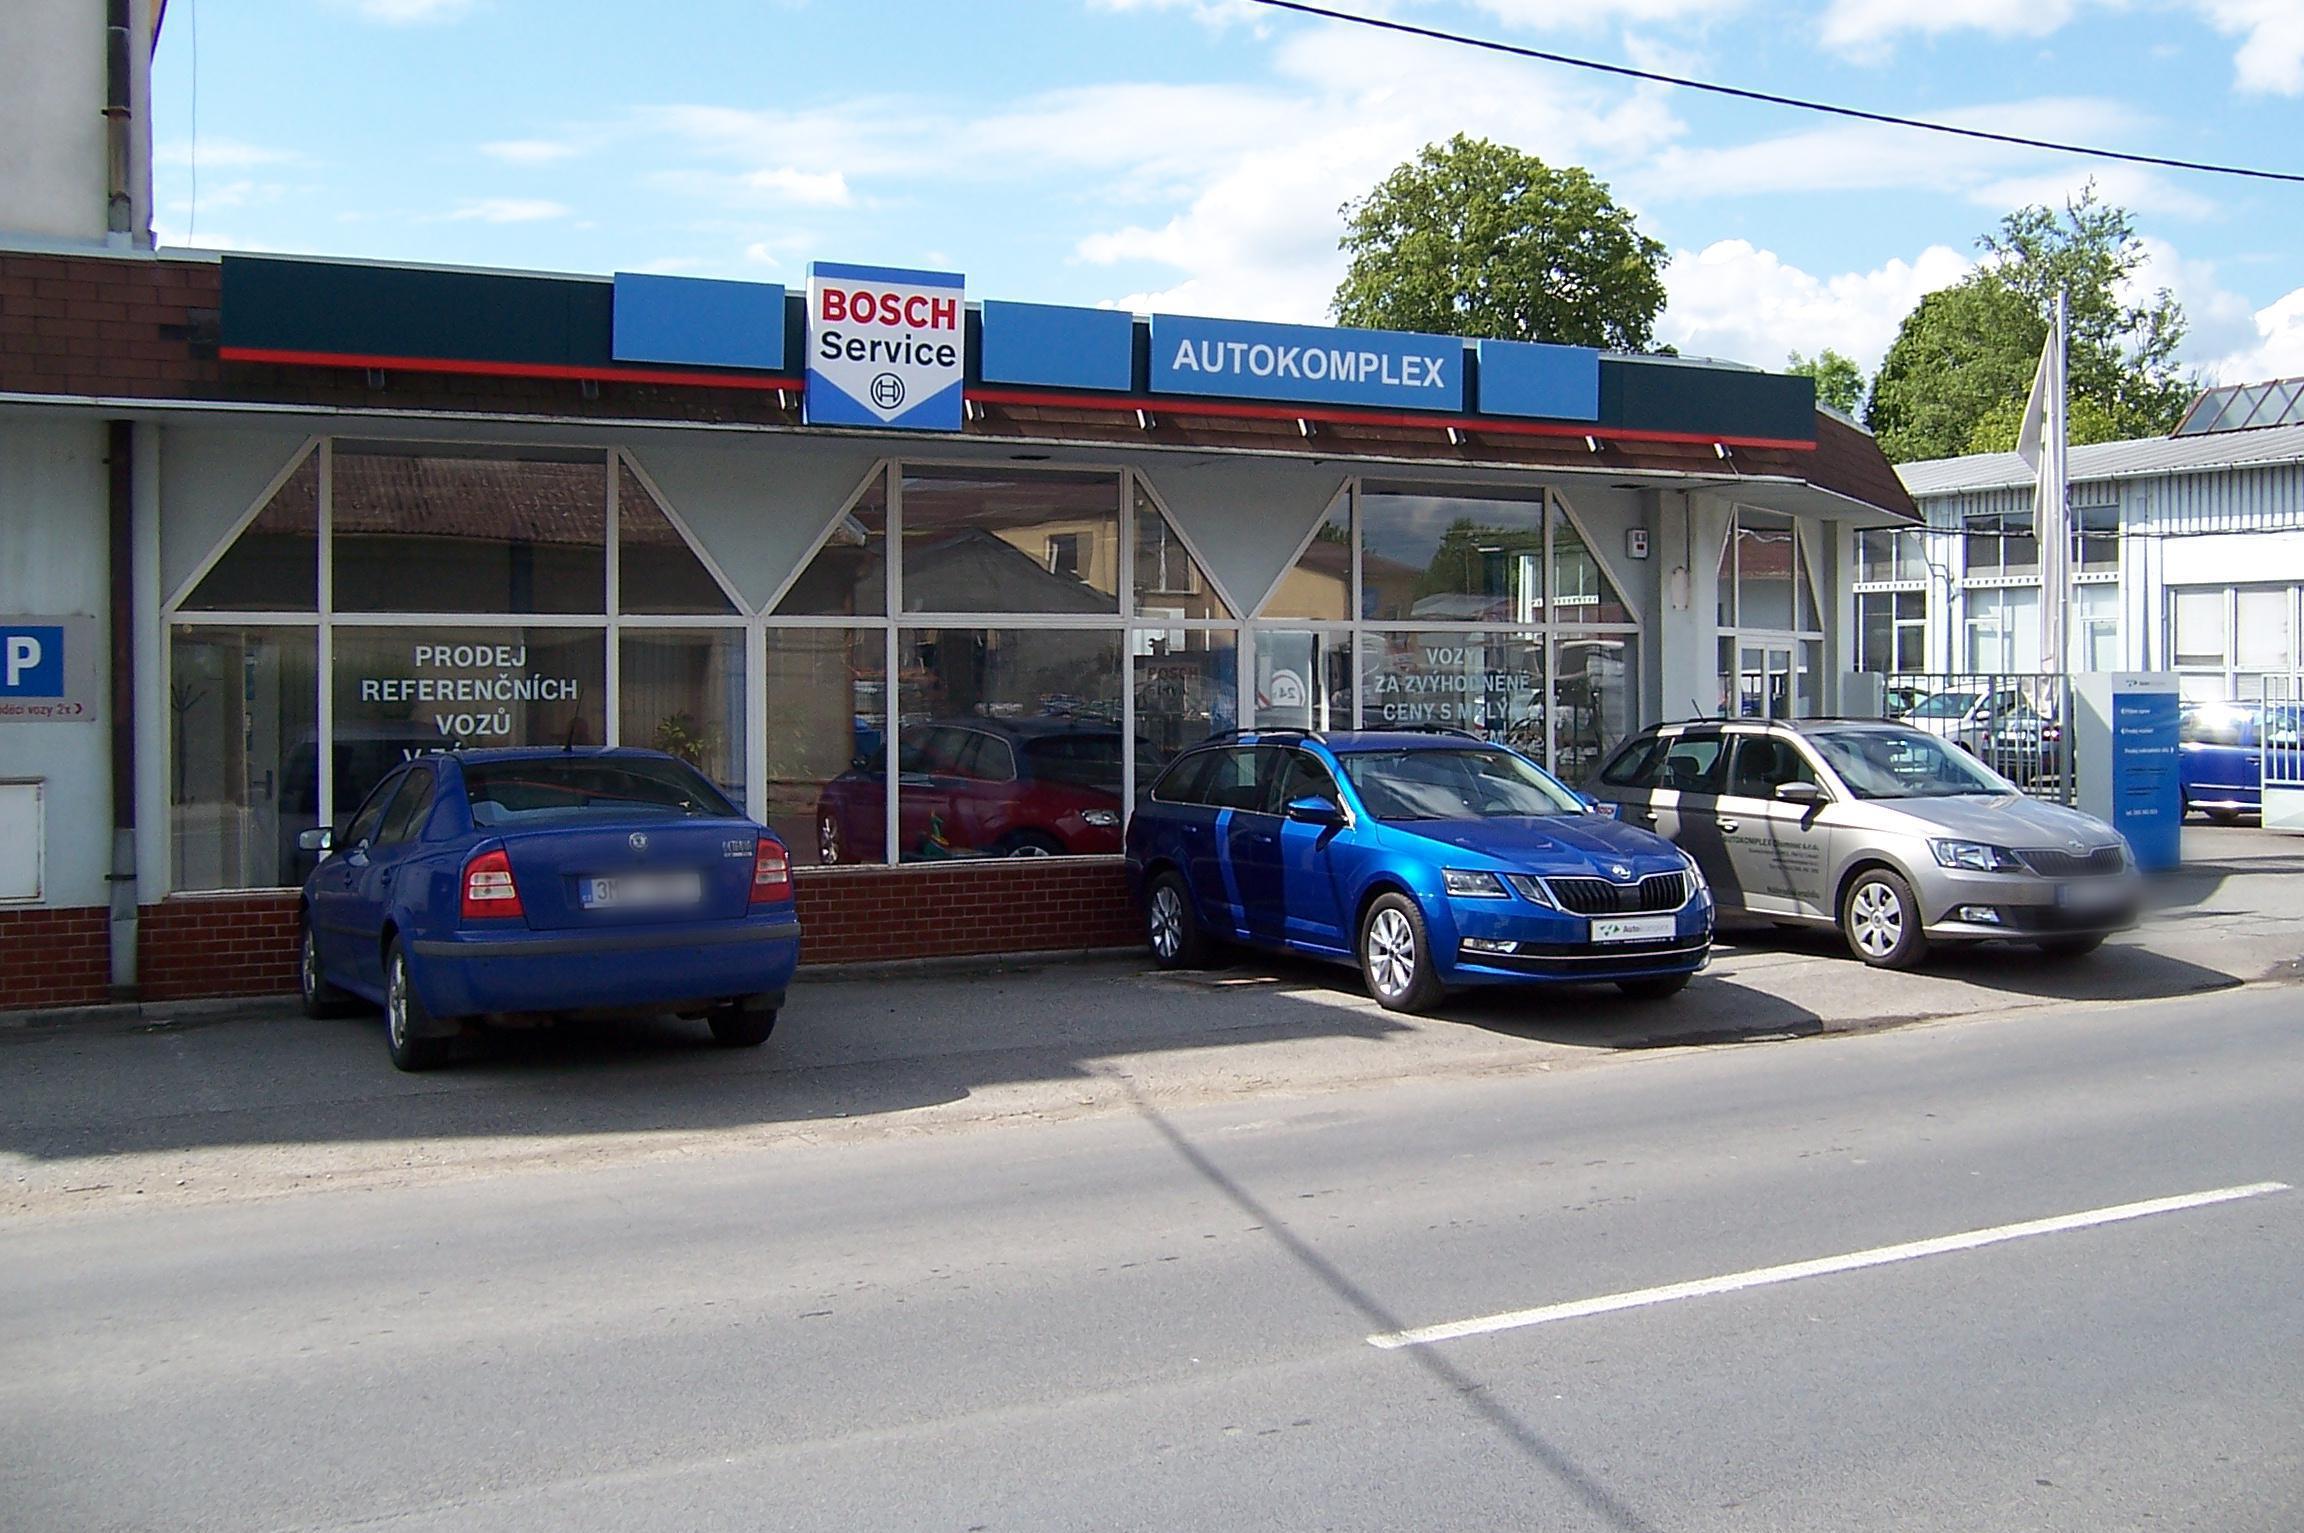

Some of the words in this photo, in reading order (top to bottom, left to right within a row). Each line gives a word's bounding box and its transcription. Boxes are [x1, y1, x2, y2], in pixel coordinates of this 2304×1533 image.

[822, 289, 956, 330] BOSCH
[820, 331, 956, 367] Service
[1172, 339, 1445, 388] AUTOKOMPLEX
[7, 636, 42, 686] P
[415, 646, 527, 667] PRODEJ
[1426, 648, 1476, 665] VOZY
[361, 674, 578, 701] REFERENČNÍCH
[1374, 675, 1400, 693] ZA
[435, 707, 511, 736] VOZŮ
[1383, 703, 1435, 720] CENY
[1440, 703, 1452, 720] S
